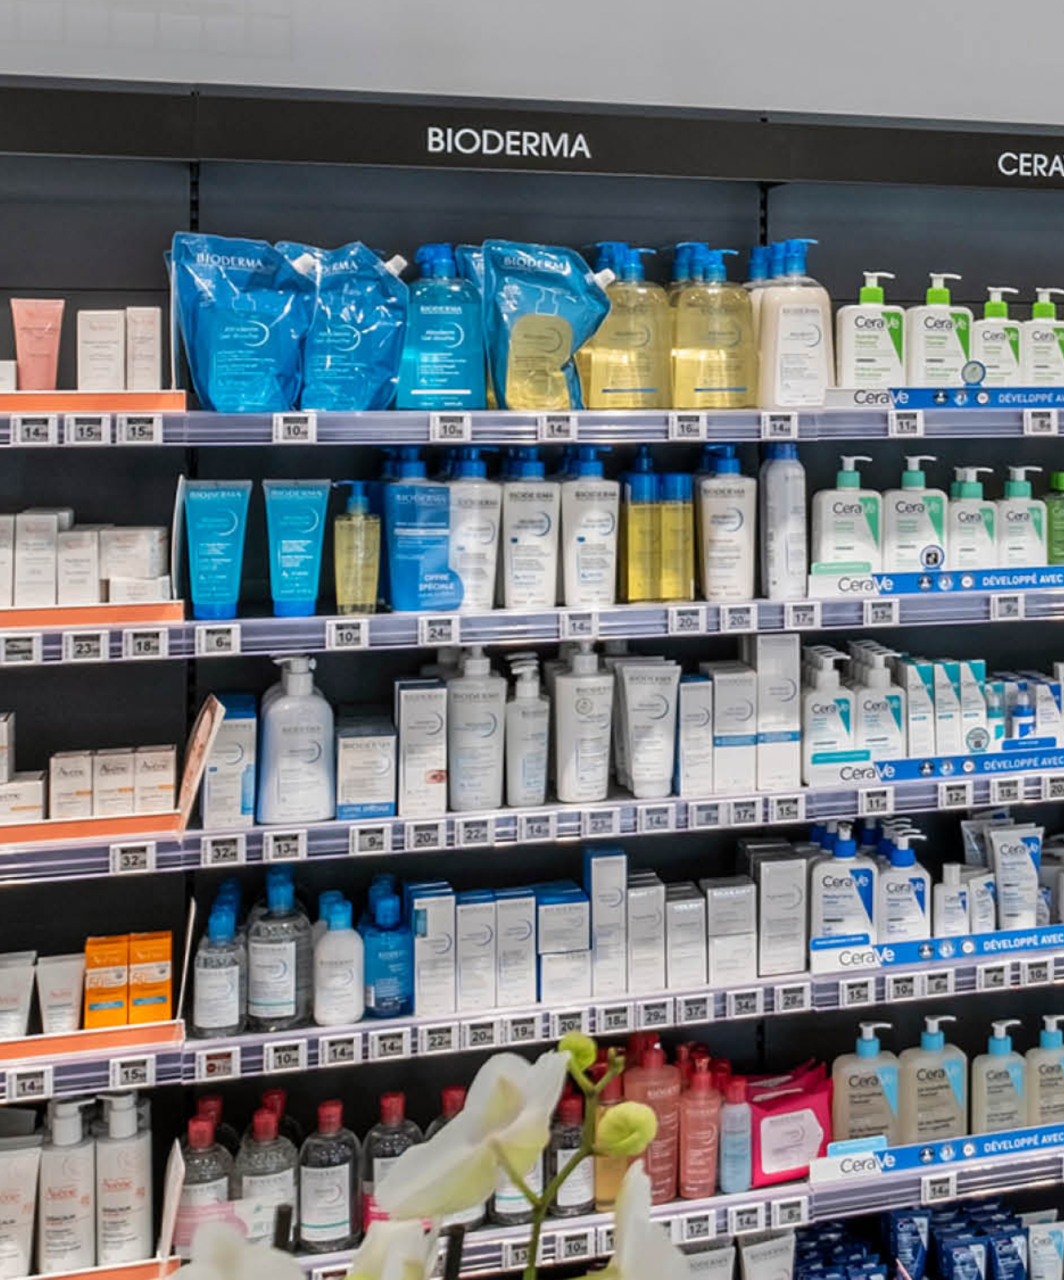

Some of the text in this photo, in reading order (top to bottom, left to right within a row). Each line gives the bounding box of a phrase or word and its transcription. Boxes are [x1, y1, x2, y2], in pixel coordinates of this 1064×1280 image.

[427, 127, 591, 159] BIODERMA
[196, 253, 263, 268] BIODERMA
[854, 315, 901, 330] CeraVe
[924, 315, 967, 330] CeraVe
[853, 389, 909, 406] CeraVe
[895, 500, 940, 514] CeraVe
[838, 575, 894, 593] CeraVe
[982, 573, 1037, 587] DÉVELOPPÉ
[1039, 572, 1064, 585] AVEC
[1041, 755, 1064, 766] AVEC
[840, 763, 895, 781] CeraVe
[822, 874, 869, 889] CeraVe
[1041, 932, 1064, 945] AVEC
[838, 946, 895, 967] CeraVe
[1041, 1131, 1064, 1145] AVEC
[840, 1152, 896, 1174] CeraVe
